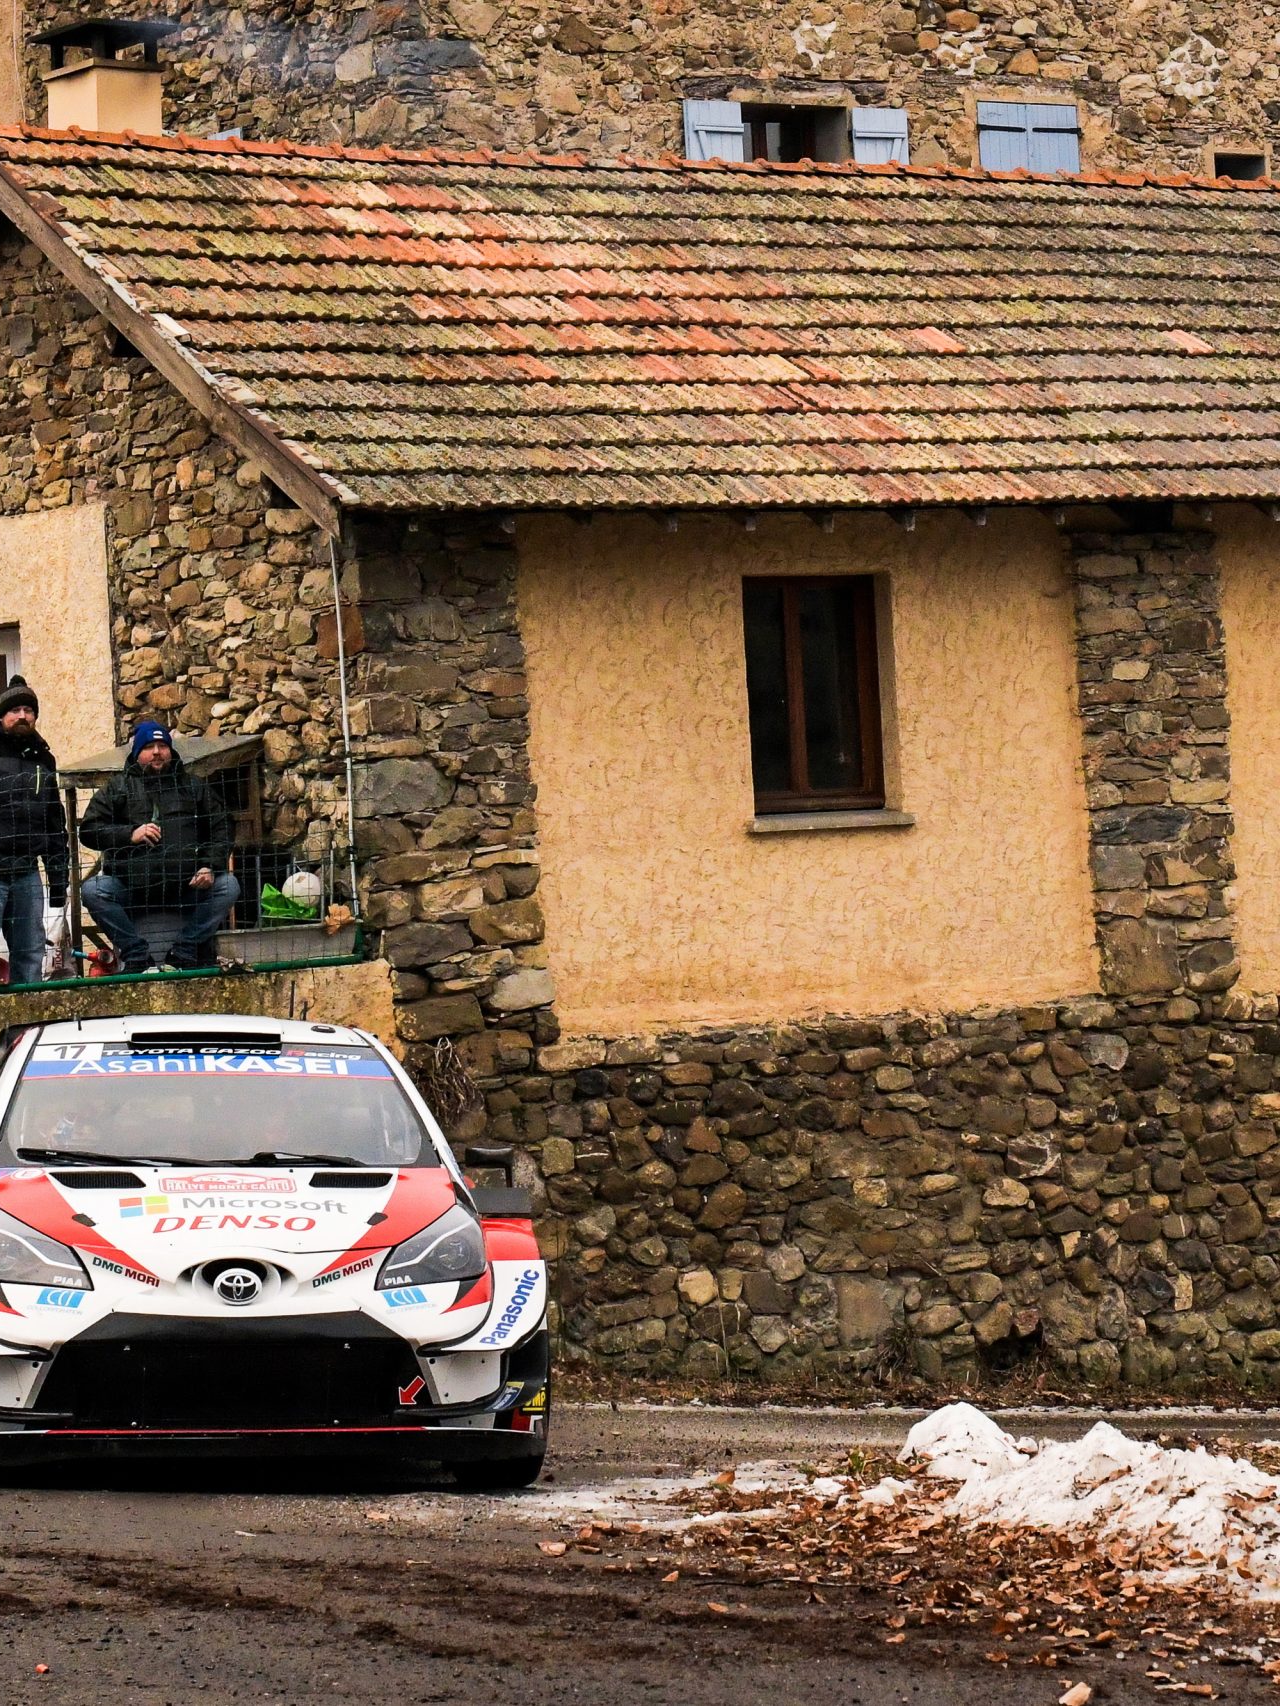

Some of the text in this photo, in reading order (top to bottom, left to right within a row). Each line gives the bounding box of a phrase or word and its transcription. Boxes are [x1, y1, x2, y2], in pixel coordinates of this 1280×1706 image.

[54, 1045, 87, 1060] 17
[103, 1047, 362, 1061] TOYOTA GAZOO Racing
[166, 1180, 206, 1191] RALLYE
[182, 1197, 349, 1215] Microsoft
[152, 1215, 316, 1234] DENSO
[92, 1256, 160, 1288] DMG MORI
[312, 1257, 374, 1289] DMG MORI
[53, 1275, 83, 1288] PIAA
[383, 1275, 413, 1287] PIAA
[479, 1268, 540, 1346] Panasonic
